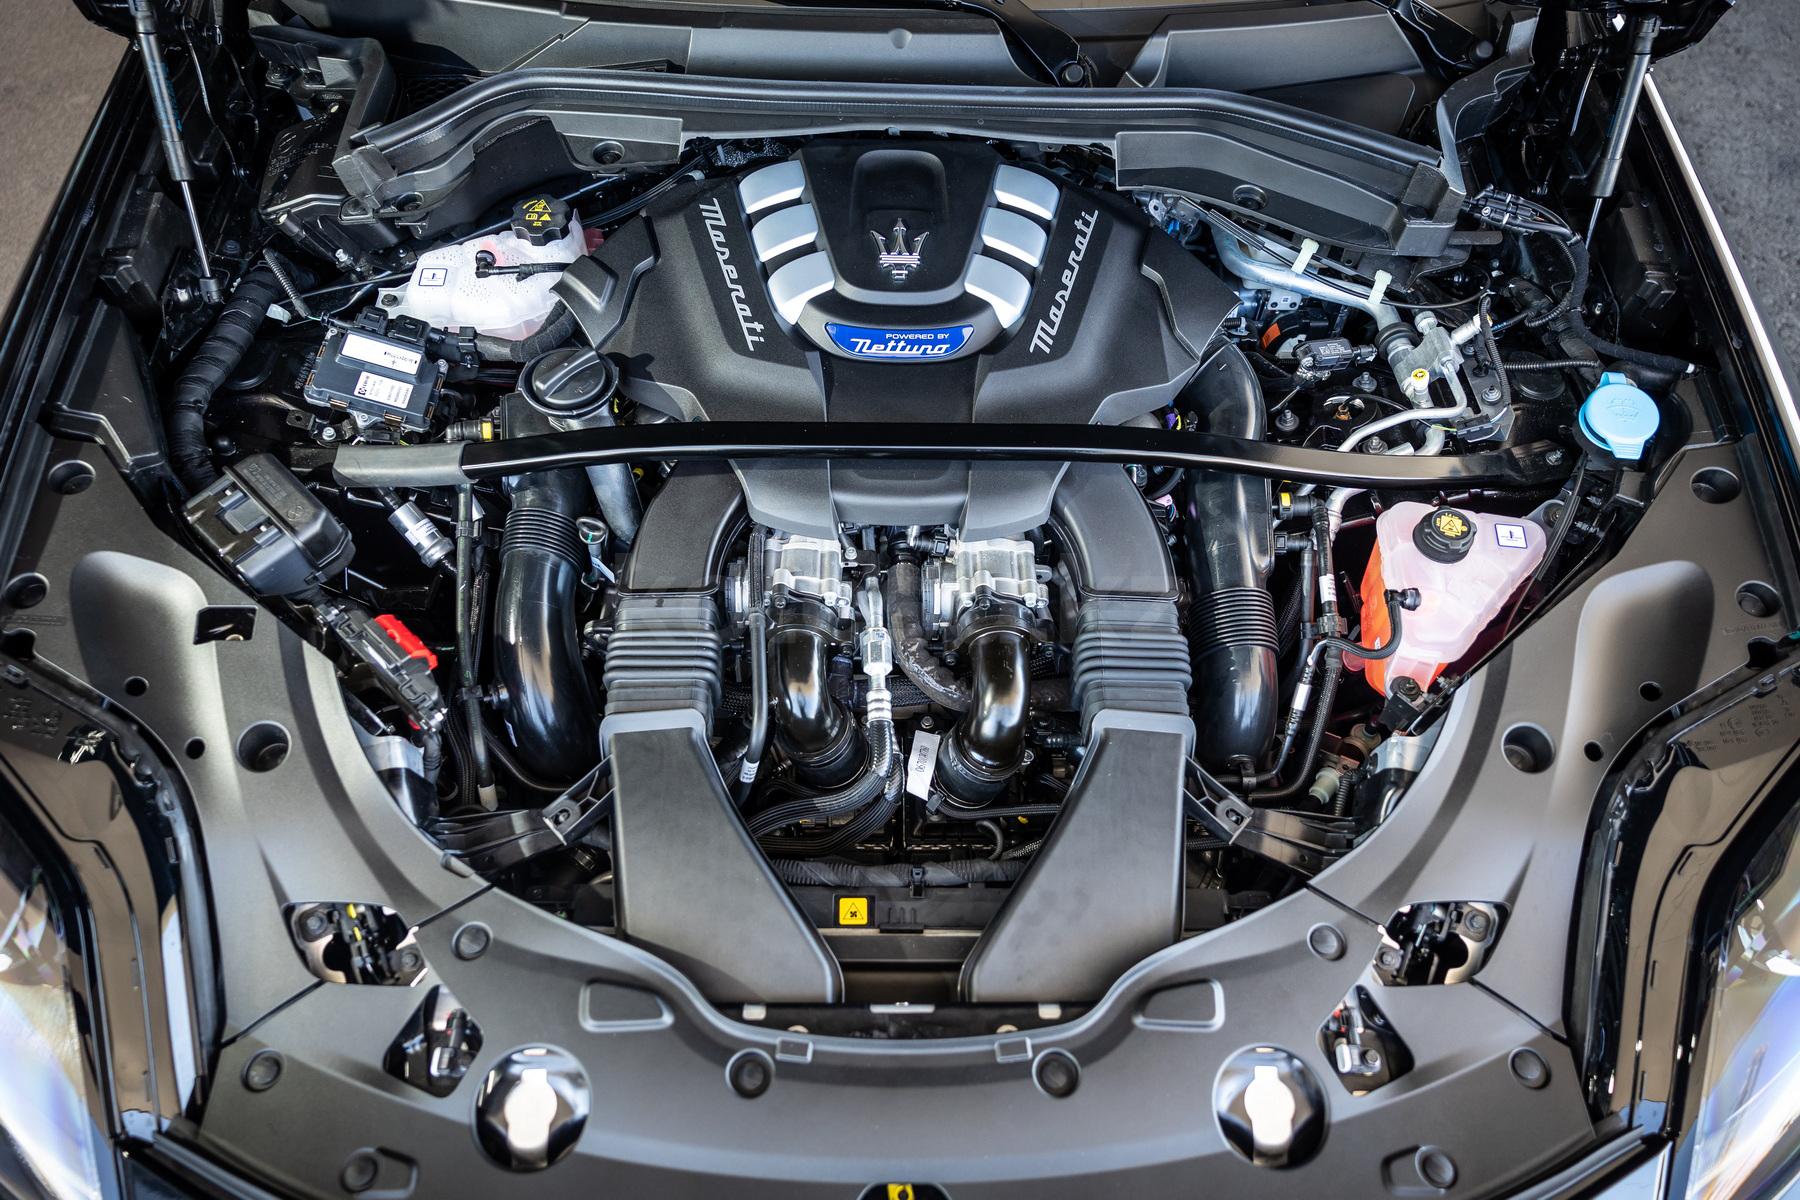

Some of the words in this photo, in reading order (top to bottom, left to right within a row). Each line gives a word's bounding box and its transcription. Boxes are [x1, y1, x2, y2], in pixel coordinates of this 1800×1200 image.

[699, 198, 764, 351] Maserati
[850, 338, 950, 354] Nettuno
[1029, 209, 1099, 354] Maserati
